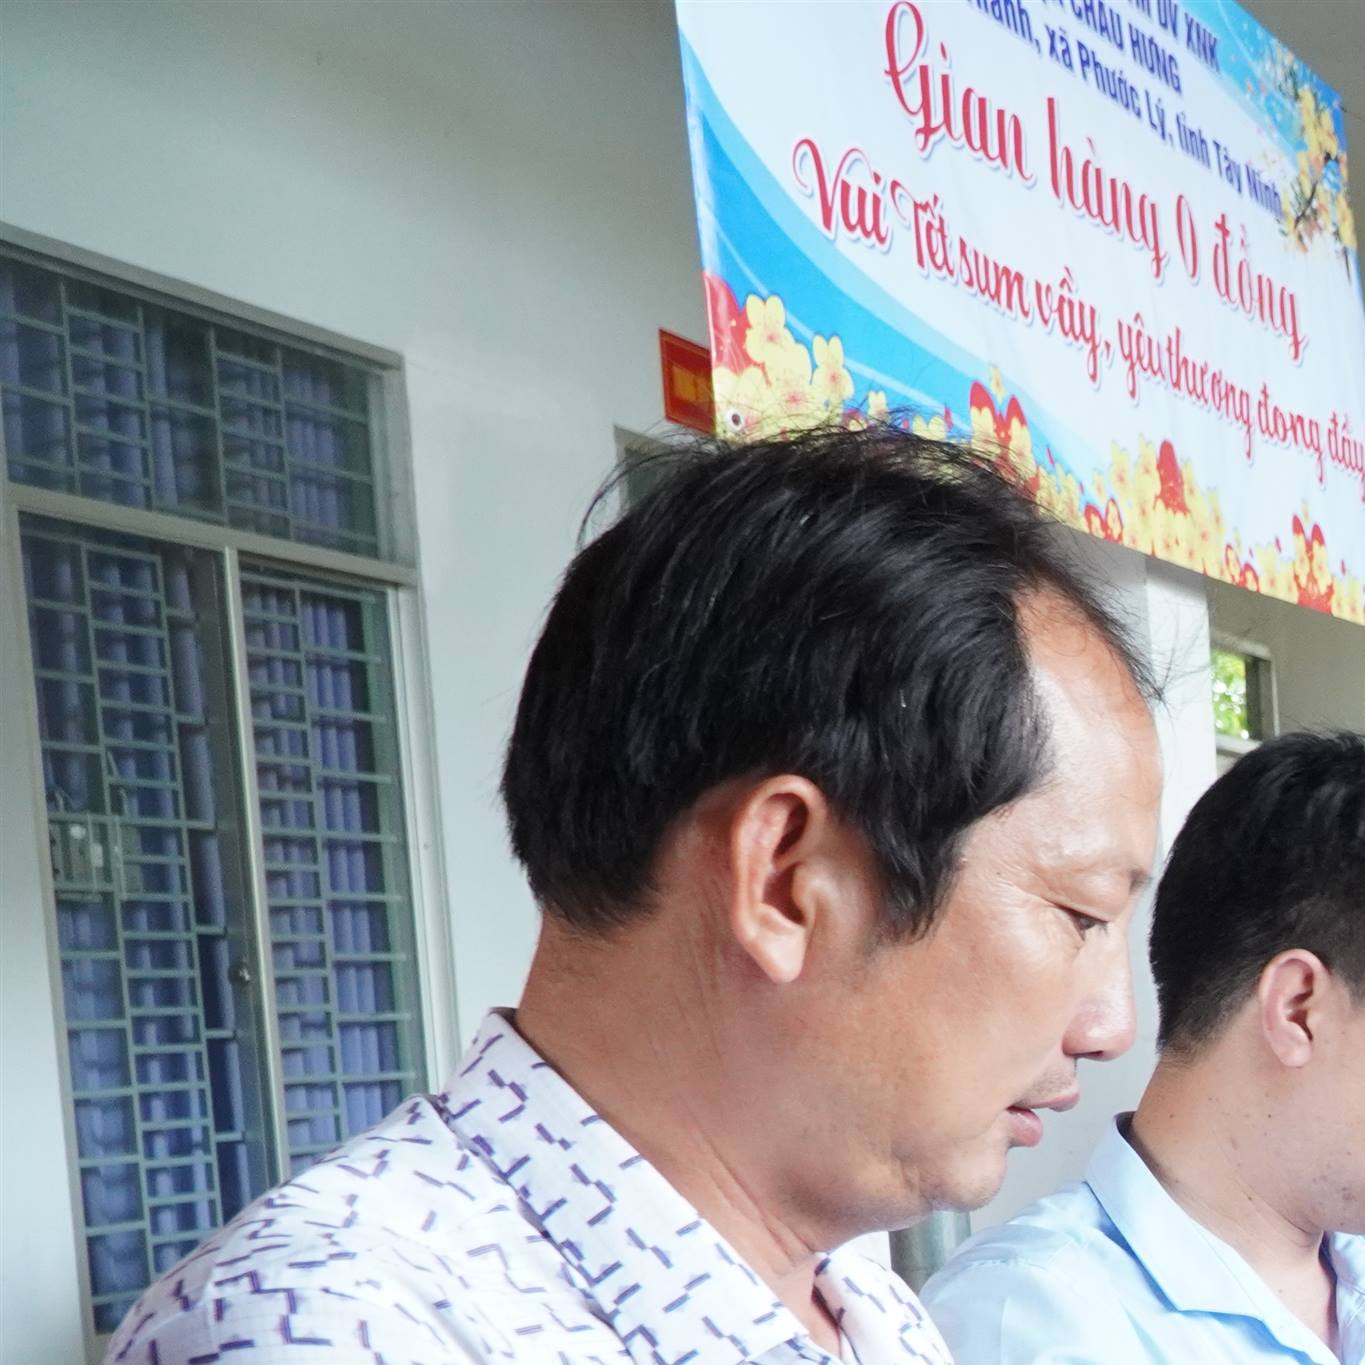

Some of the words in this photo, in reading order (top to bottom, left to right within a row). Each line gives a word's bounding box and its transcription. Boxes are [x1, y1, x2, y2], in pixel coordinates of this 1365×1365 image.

[1045, 24, 1074, 71] xã
[793, 138, 888, 245] Vui
[959, 235, 1030, 317] sum
[883, 2, 1034, 181] Gian
[1048, 97, 1166, 279] hàng
[1213, 214, 1304, 360] đồng
